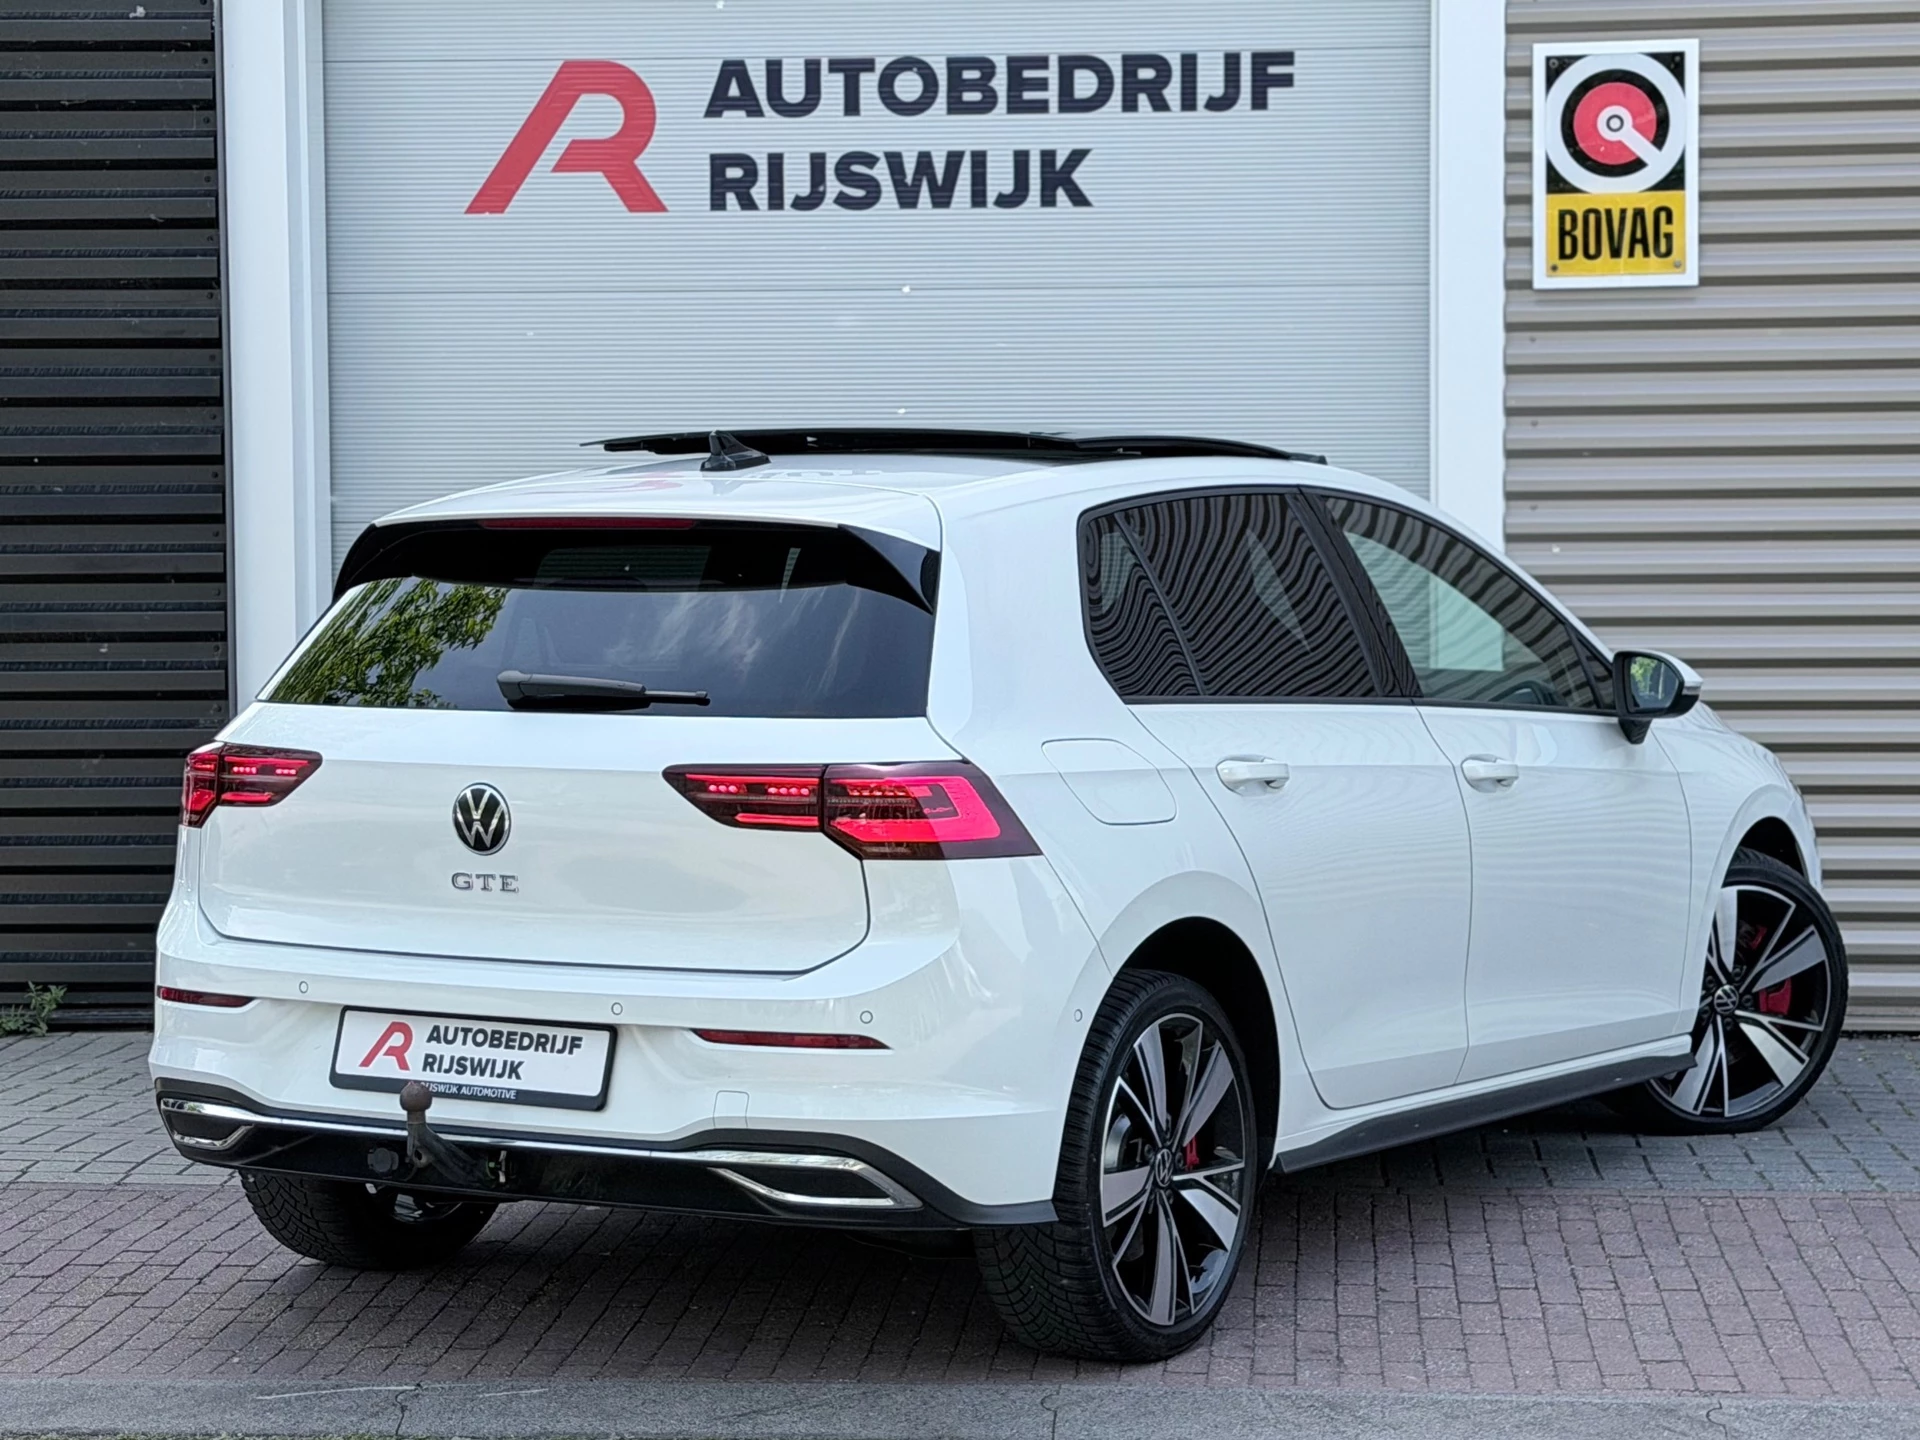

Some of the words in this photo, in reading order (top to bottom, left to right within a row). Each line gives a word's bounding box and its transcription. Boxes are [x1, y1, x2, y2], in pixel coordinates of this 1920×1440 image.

[704, 51, 1295, 117] AUTOBEDRIJF
[709, 149, 1092, 211] RIJSWIJK
[1558, 206, 1674, 261] BOVAG
[451, 872, 519, 893] GTE
[425, 1025, 583, 1055] AUTOBEDRIJF
[421, 1053, 525, 1080] RIJSWIJK
[460, 1086, 517, 1100] AUTOMOTIVE
